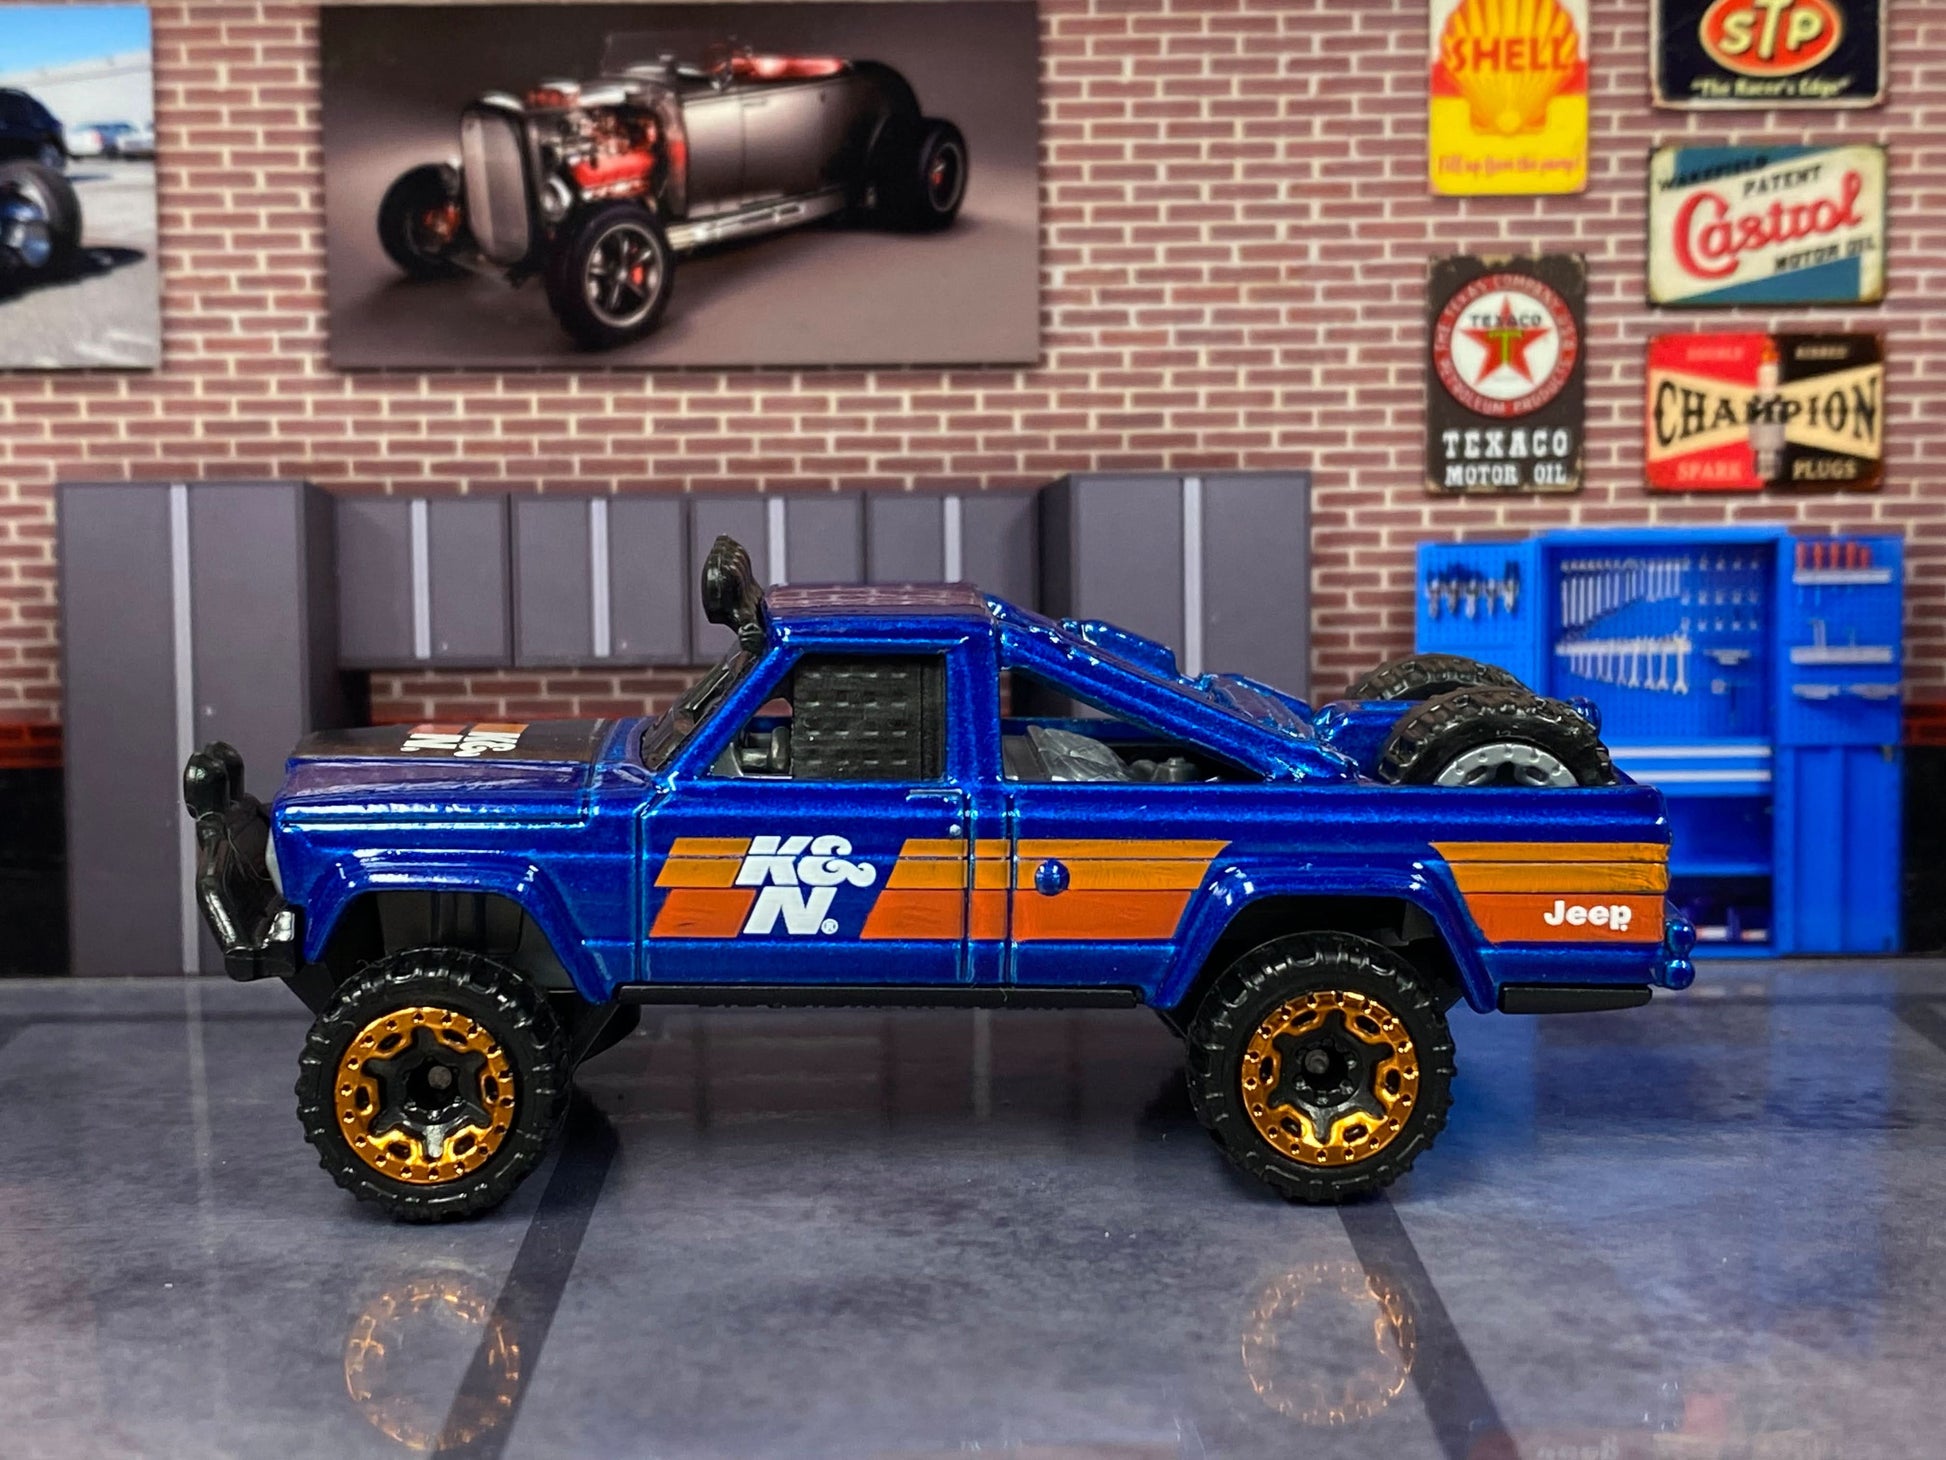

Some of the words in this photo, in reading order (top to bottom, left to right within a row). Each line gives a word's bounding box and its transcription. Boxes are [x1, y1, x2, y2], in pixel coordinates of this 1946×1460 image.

[1719, 0, 1825, 59] STP
[1452, 36, 1568, 73] SHELL
[1742, 165, 1822, 198] PATENT
[1672, 169, 1865, 281] Castrol
[1774, 244, 1839, 275] MOTOR
[1470, 313, 1543, 327] TEXACO
[1654, 376, 1878, 447] CHAMPION
[1442, 429, 1569, 459] TEXACO
[1444, 464, 1520, 487] MOTOR
[1533, 462, 1568, 485] OIL
[1677, 459, 1743, 482] SPARK
[1792, 458, 1858, 480] PLUGS
[1543, 899, 1632, 931] Jeep
